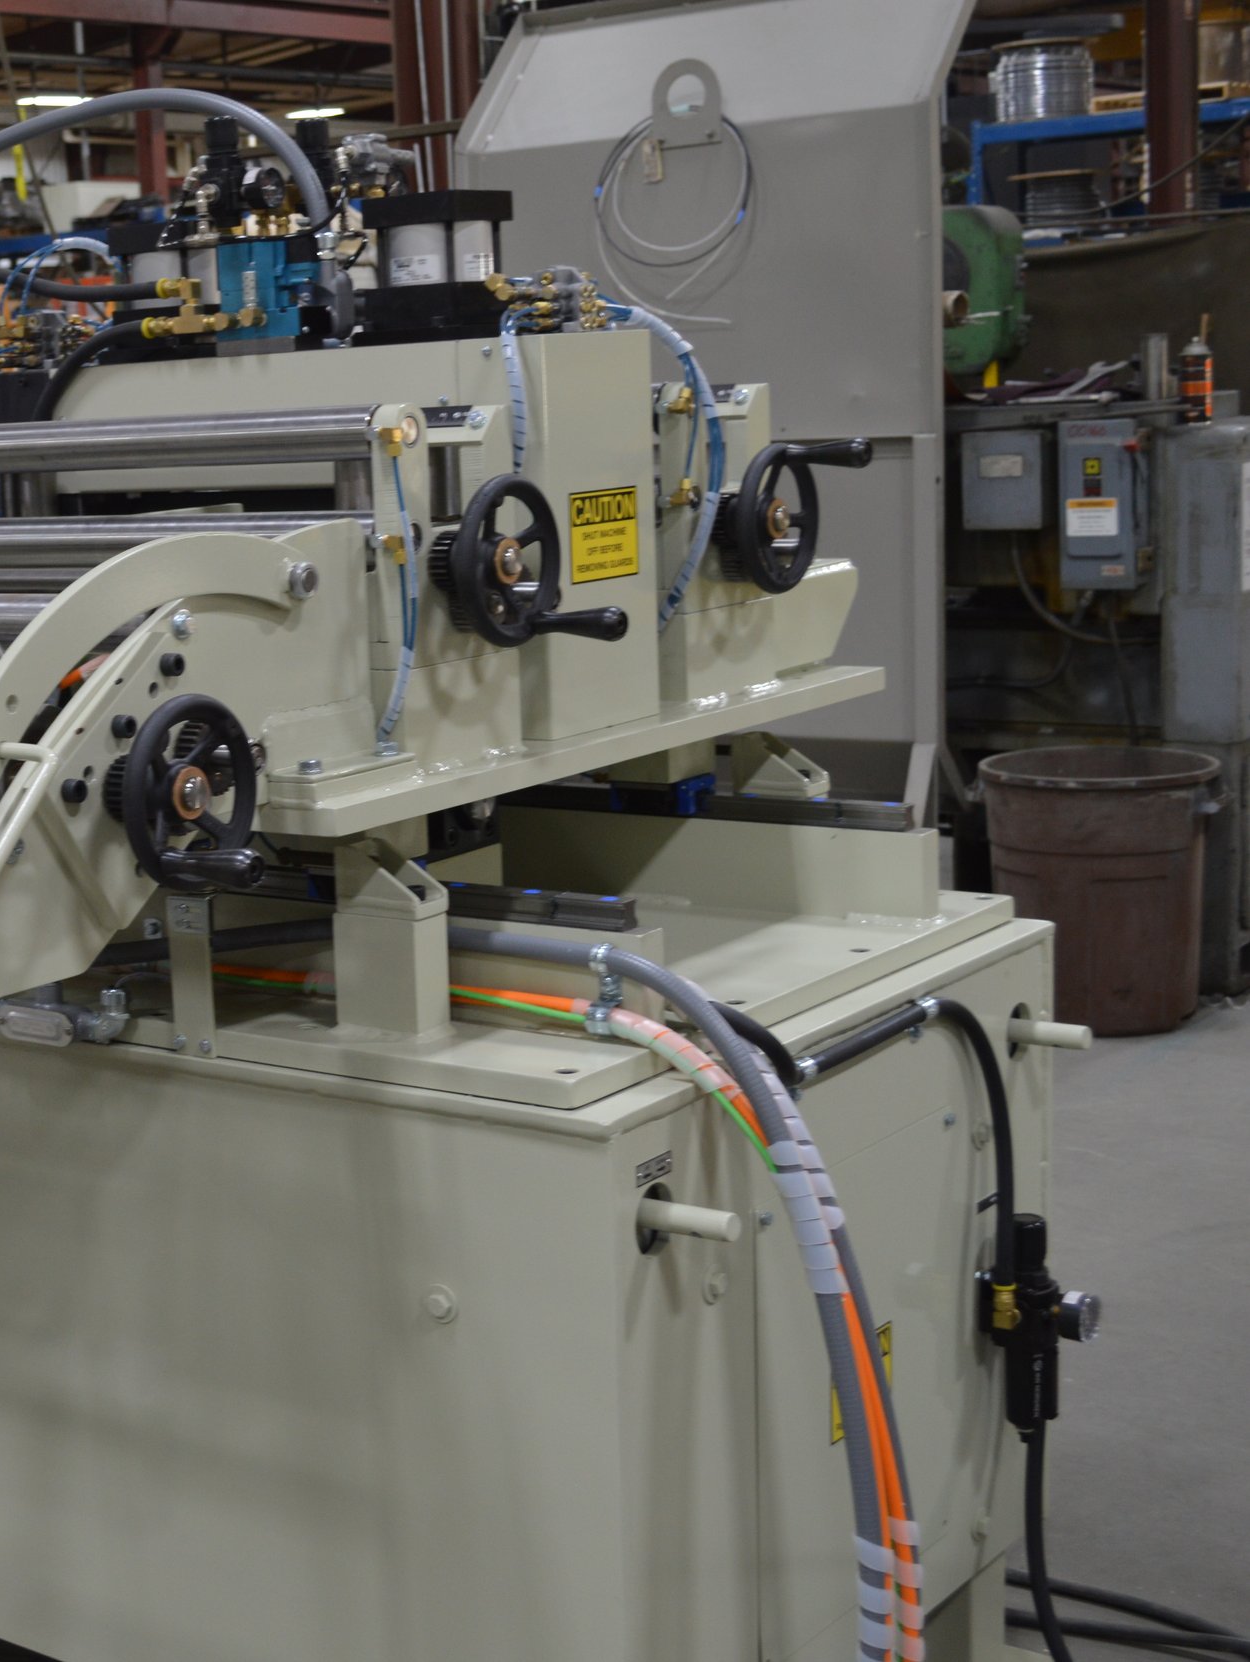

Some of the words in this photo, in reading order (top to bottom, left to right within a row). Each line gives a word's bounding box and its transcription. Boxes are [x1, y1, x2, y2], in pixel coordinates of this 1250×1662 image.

[573, 492, 635, 525] CAUTION
[582, 530, 598, 541] SHUT
[600, 526, 627, 538] MACHINE
[587, 546, 598, 556] OFF
[600, 543, 623, 554] BEFORE
[577, 561, 607, 573] REMOVING
[609, 557, 634, 569] GUARDS
